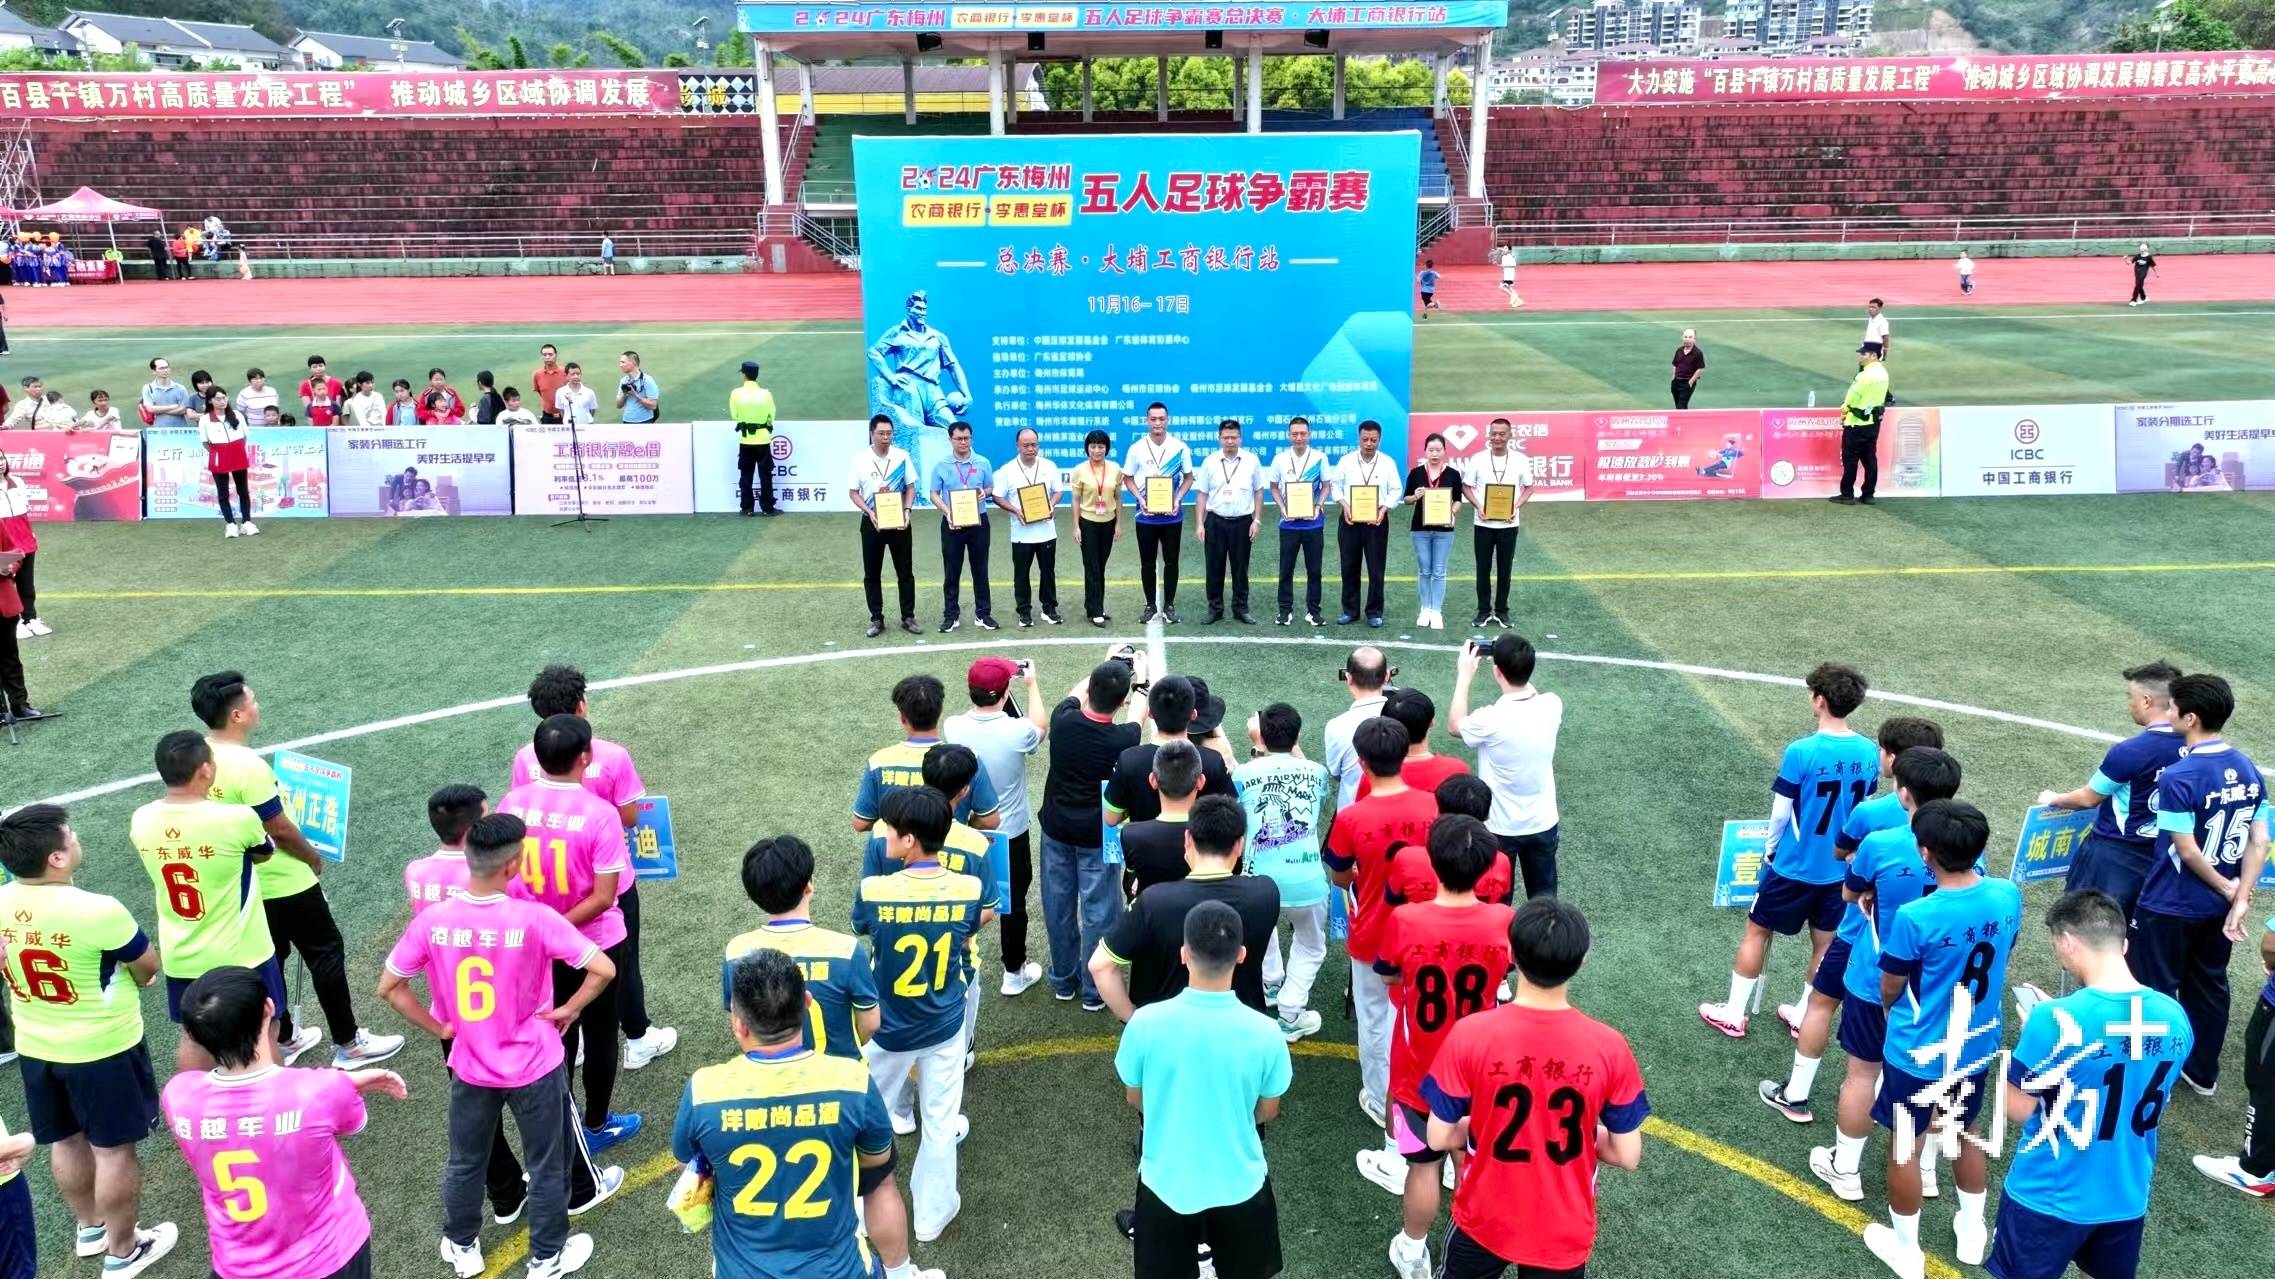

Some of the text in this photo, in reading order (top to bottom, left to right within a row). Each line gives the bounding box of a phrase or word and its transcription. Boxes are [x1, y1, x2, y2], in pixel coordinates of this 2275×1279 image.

[391, 78, 650, 107] 推动城乡区域协调发展
[1079, 170, 1370, 214] 五人足球争霸赛
[347, 439, 427, 450] 家装分期选工行
[2136, 415, 2214, 427] 家装分期选工行
[416, 453, 496, 464] 美好生活提早享
[1983, 471, 2073, 485] 中国工商银行
[2010, 449, 2044, 460] ICBC
[2201, 804, 2256, 866] 15
[161, 863, 206, 922] 6
[520, 836, 570, 895] 41
[456, 956, 496, 1022] 6
[894, 932, 952, 996] 21
[1961, 941, 1995, 1005] 8
[1415, 964, 1488, 1032] 88
[1487, 1055, 1594, 1087] 工商银行
[2097, 1060, 2173, 1141] 16
[1493, 1082, 1585, 1165] 23
[212, 1149, 268, 1223] 5
[728, 1139, 832, 1219] 22
